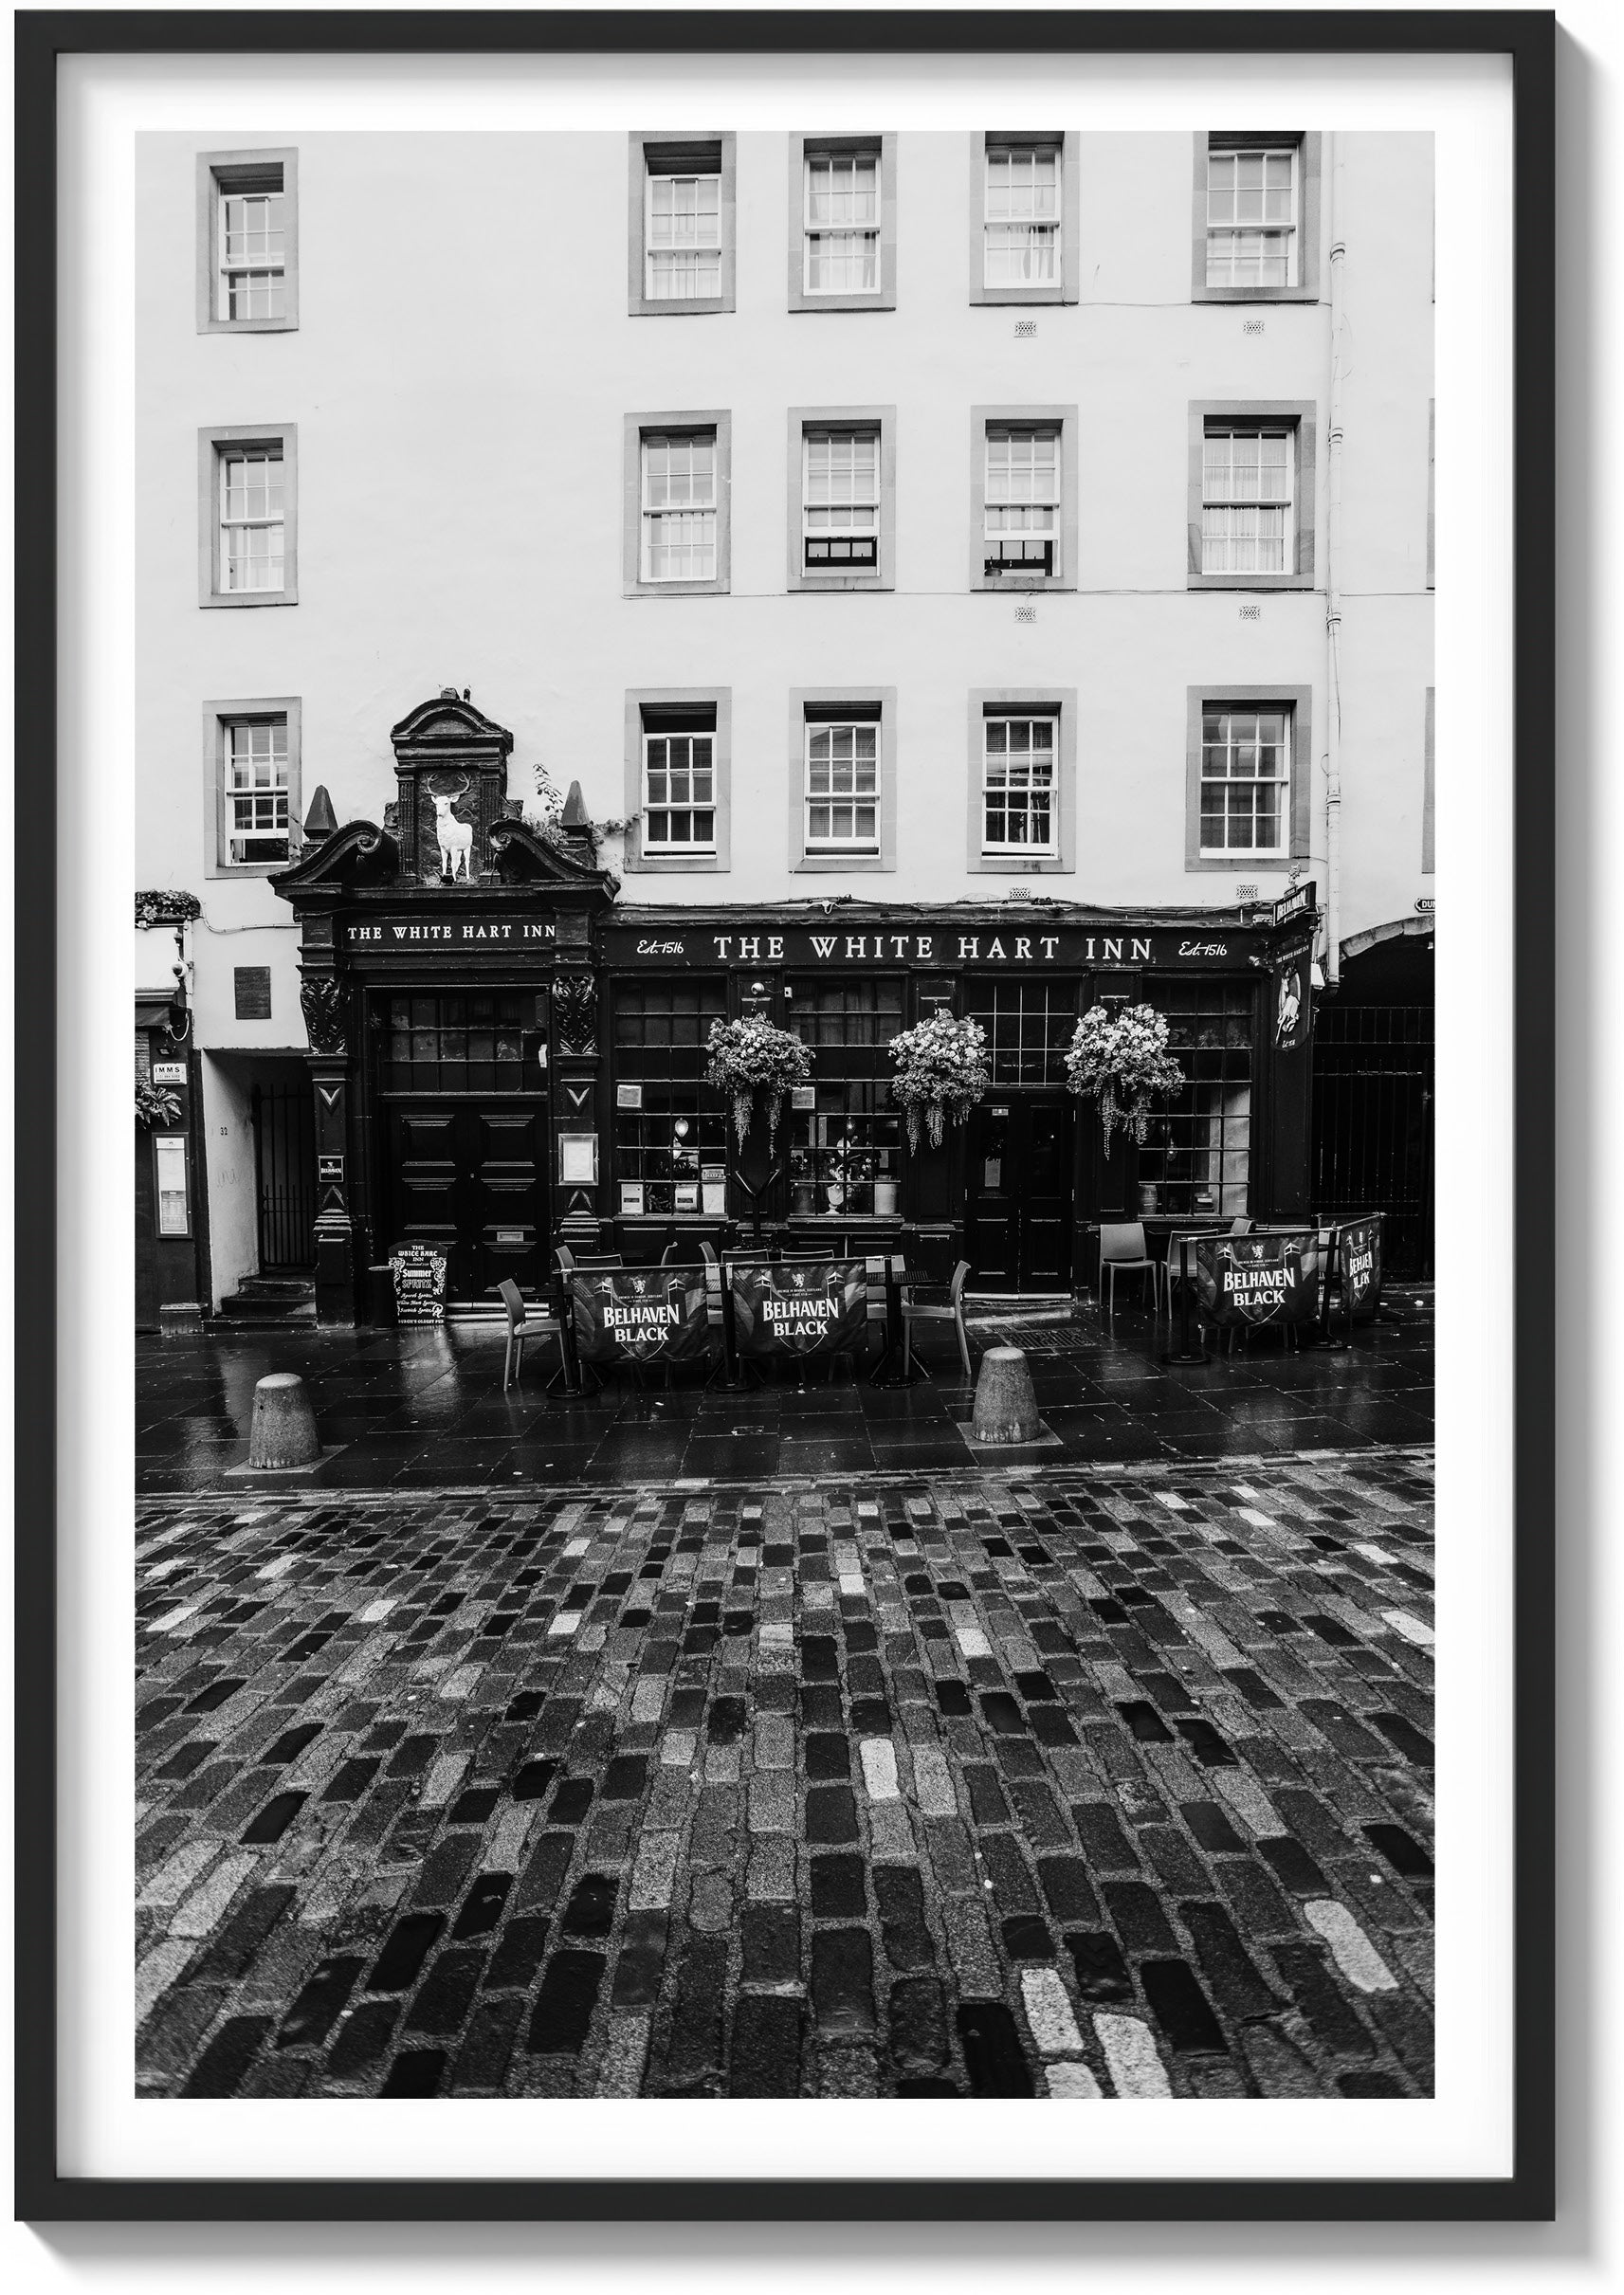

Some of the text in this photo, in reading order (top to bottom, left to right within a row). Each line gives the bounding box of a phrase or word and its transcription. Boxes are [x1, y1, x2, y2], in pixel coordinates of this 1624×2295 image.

[347, 925, 556, 939] THE WHITE HART INN
[637, 939, 684, 954] Est. 1516
[713, 936, 1152, 960] THE WHITE HART INN
[1178, 941, 1227, 956] Est. 1516
[220, 1127, 228, 1136] 32
[402, 1269, 432, 1278] Summer
[1223, 1267, 1296, 1292] BELHAVEN
[1233, 1290, 1286, 1306] BLACK
[603, 1304, 680, 1328] BELHAVEN
[763, 1297, 839, 1321] BELHAVEN
[614, 1327, 670, 1342] BLACK
[773, 1321, 829, 1337] BLACK
